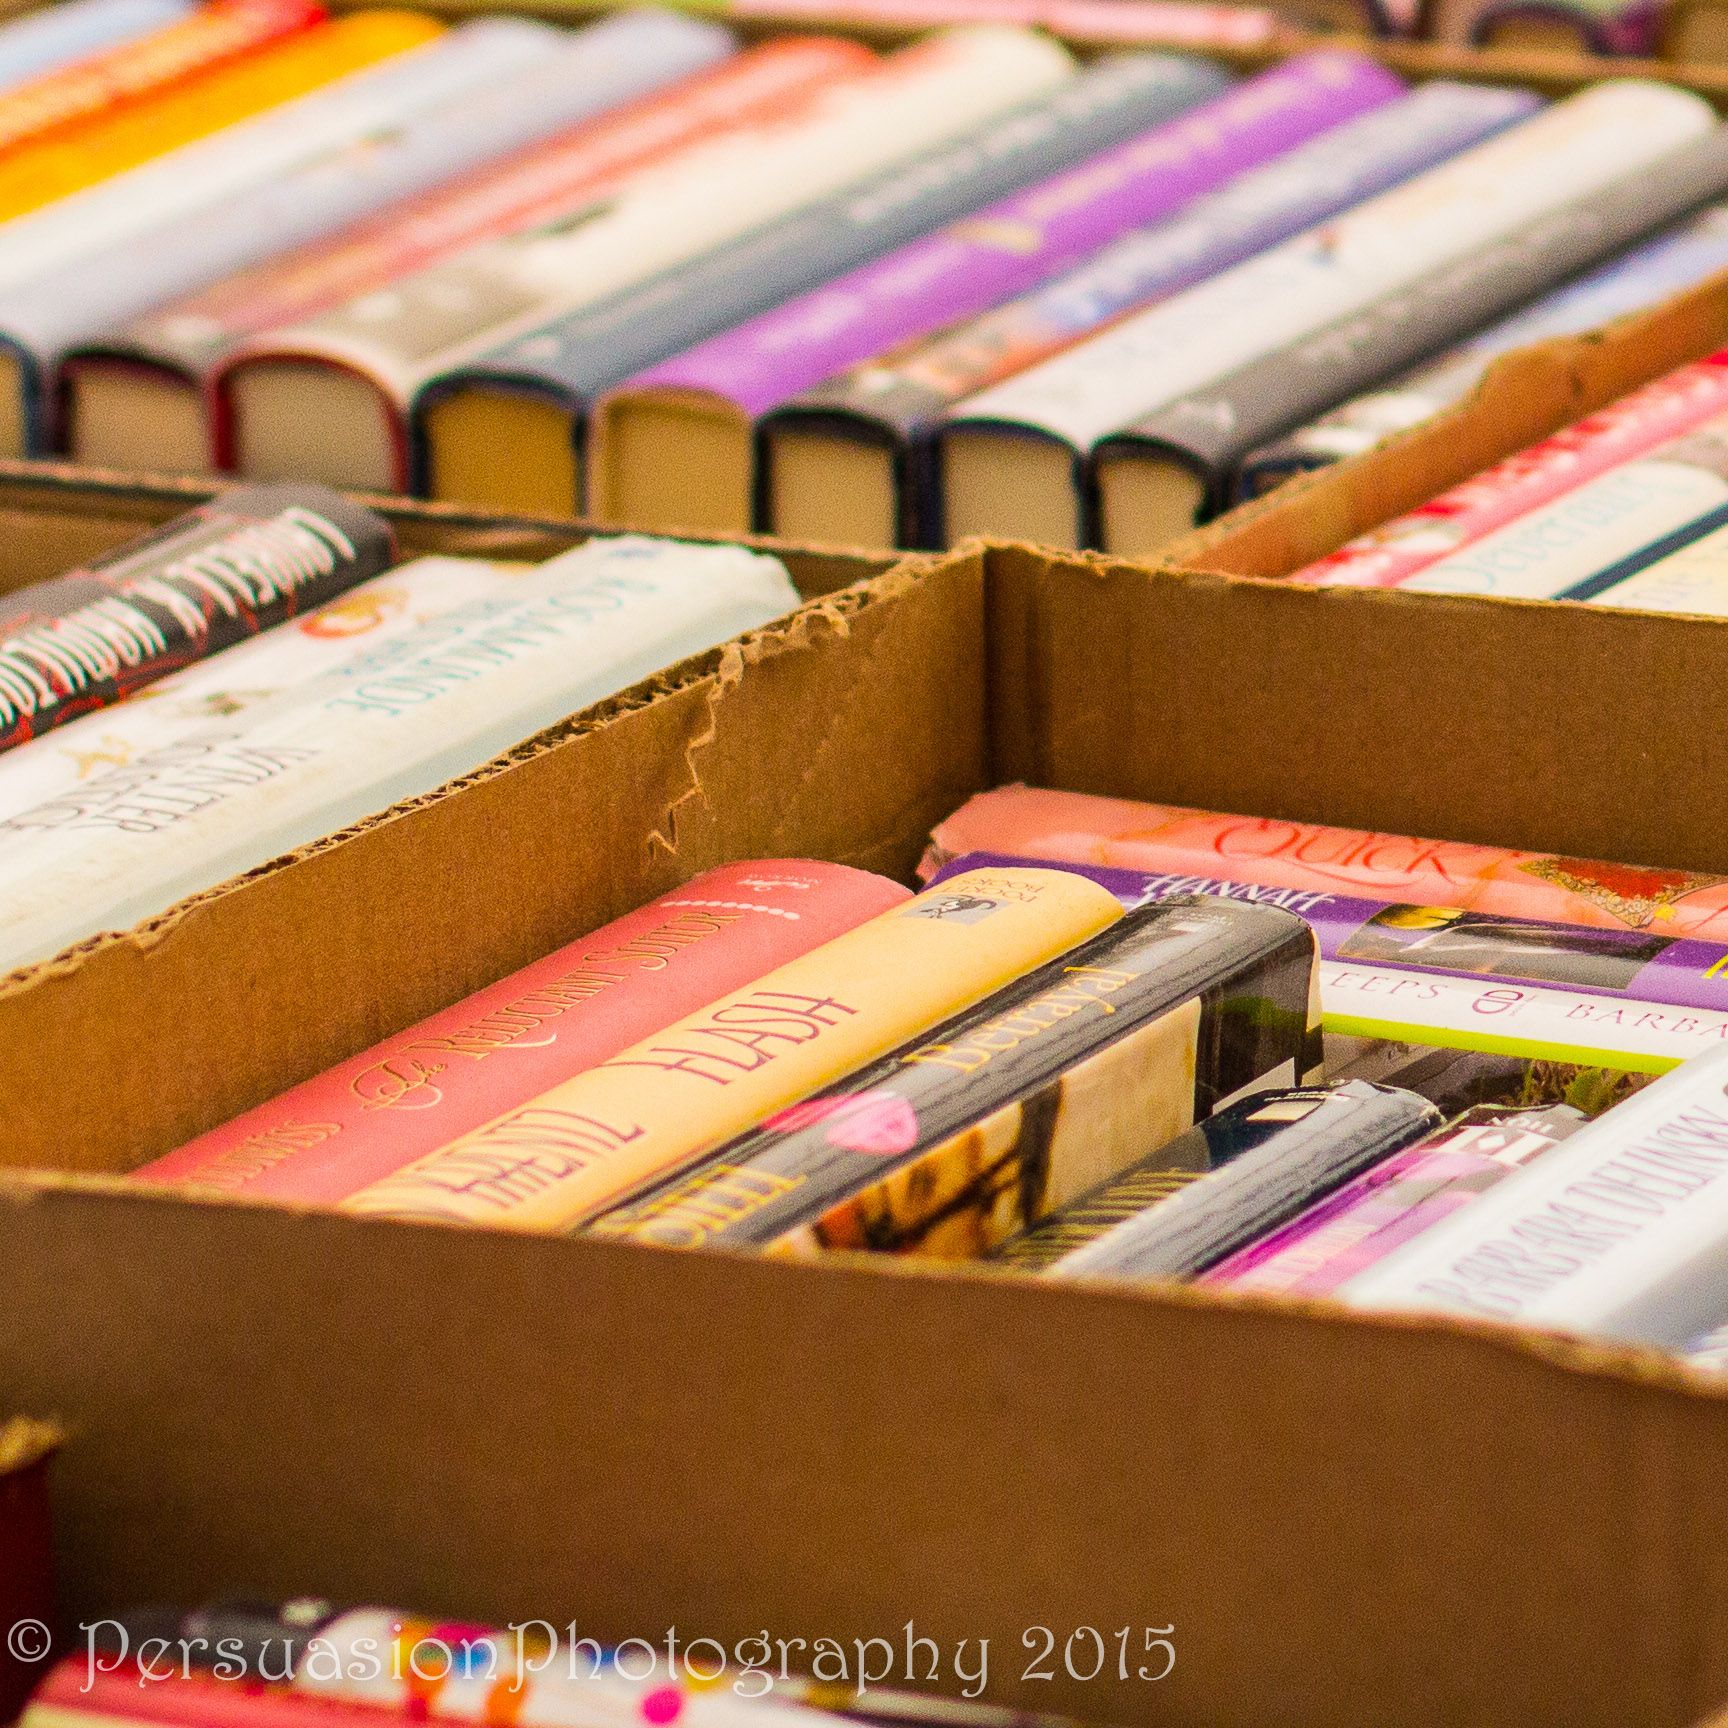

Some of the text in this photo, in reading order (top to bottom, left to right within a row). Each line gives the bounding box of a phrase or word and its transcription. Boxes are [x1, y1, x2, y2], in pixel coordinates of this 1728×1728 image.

[1143, 873, 1336, 912] HANNAH
[1213, 818, 1462, 889] QUICK
[416, 952, 632, 1060] RELUCTANT
[605, 906, 743, 972] SUITOR
[900, 964, 1139, 1073] Betrayal
[603, 991, 859, 1085] FLASH
